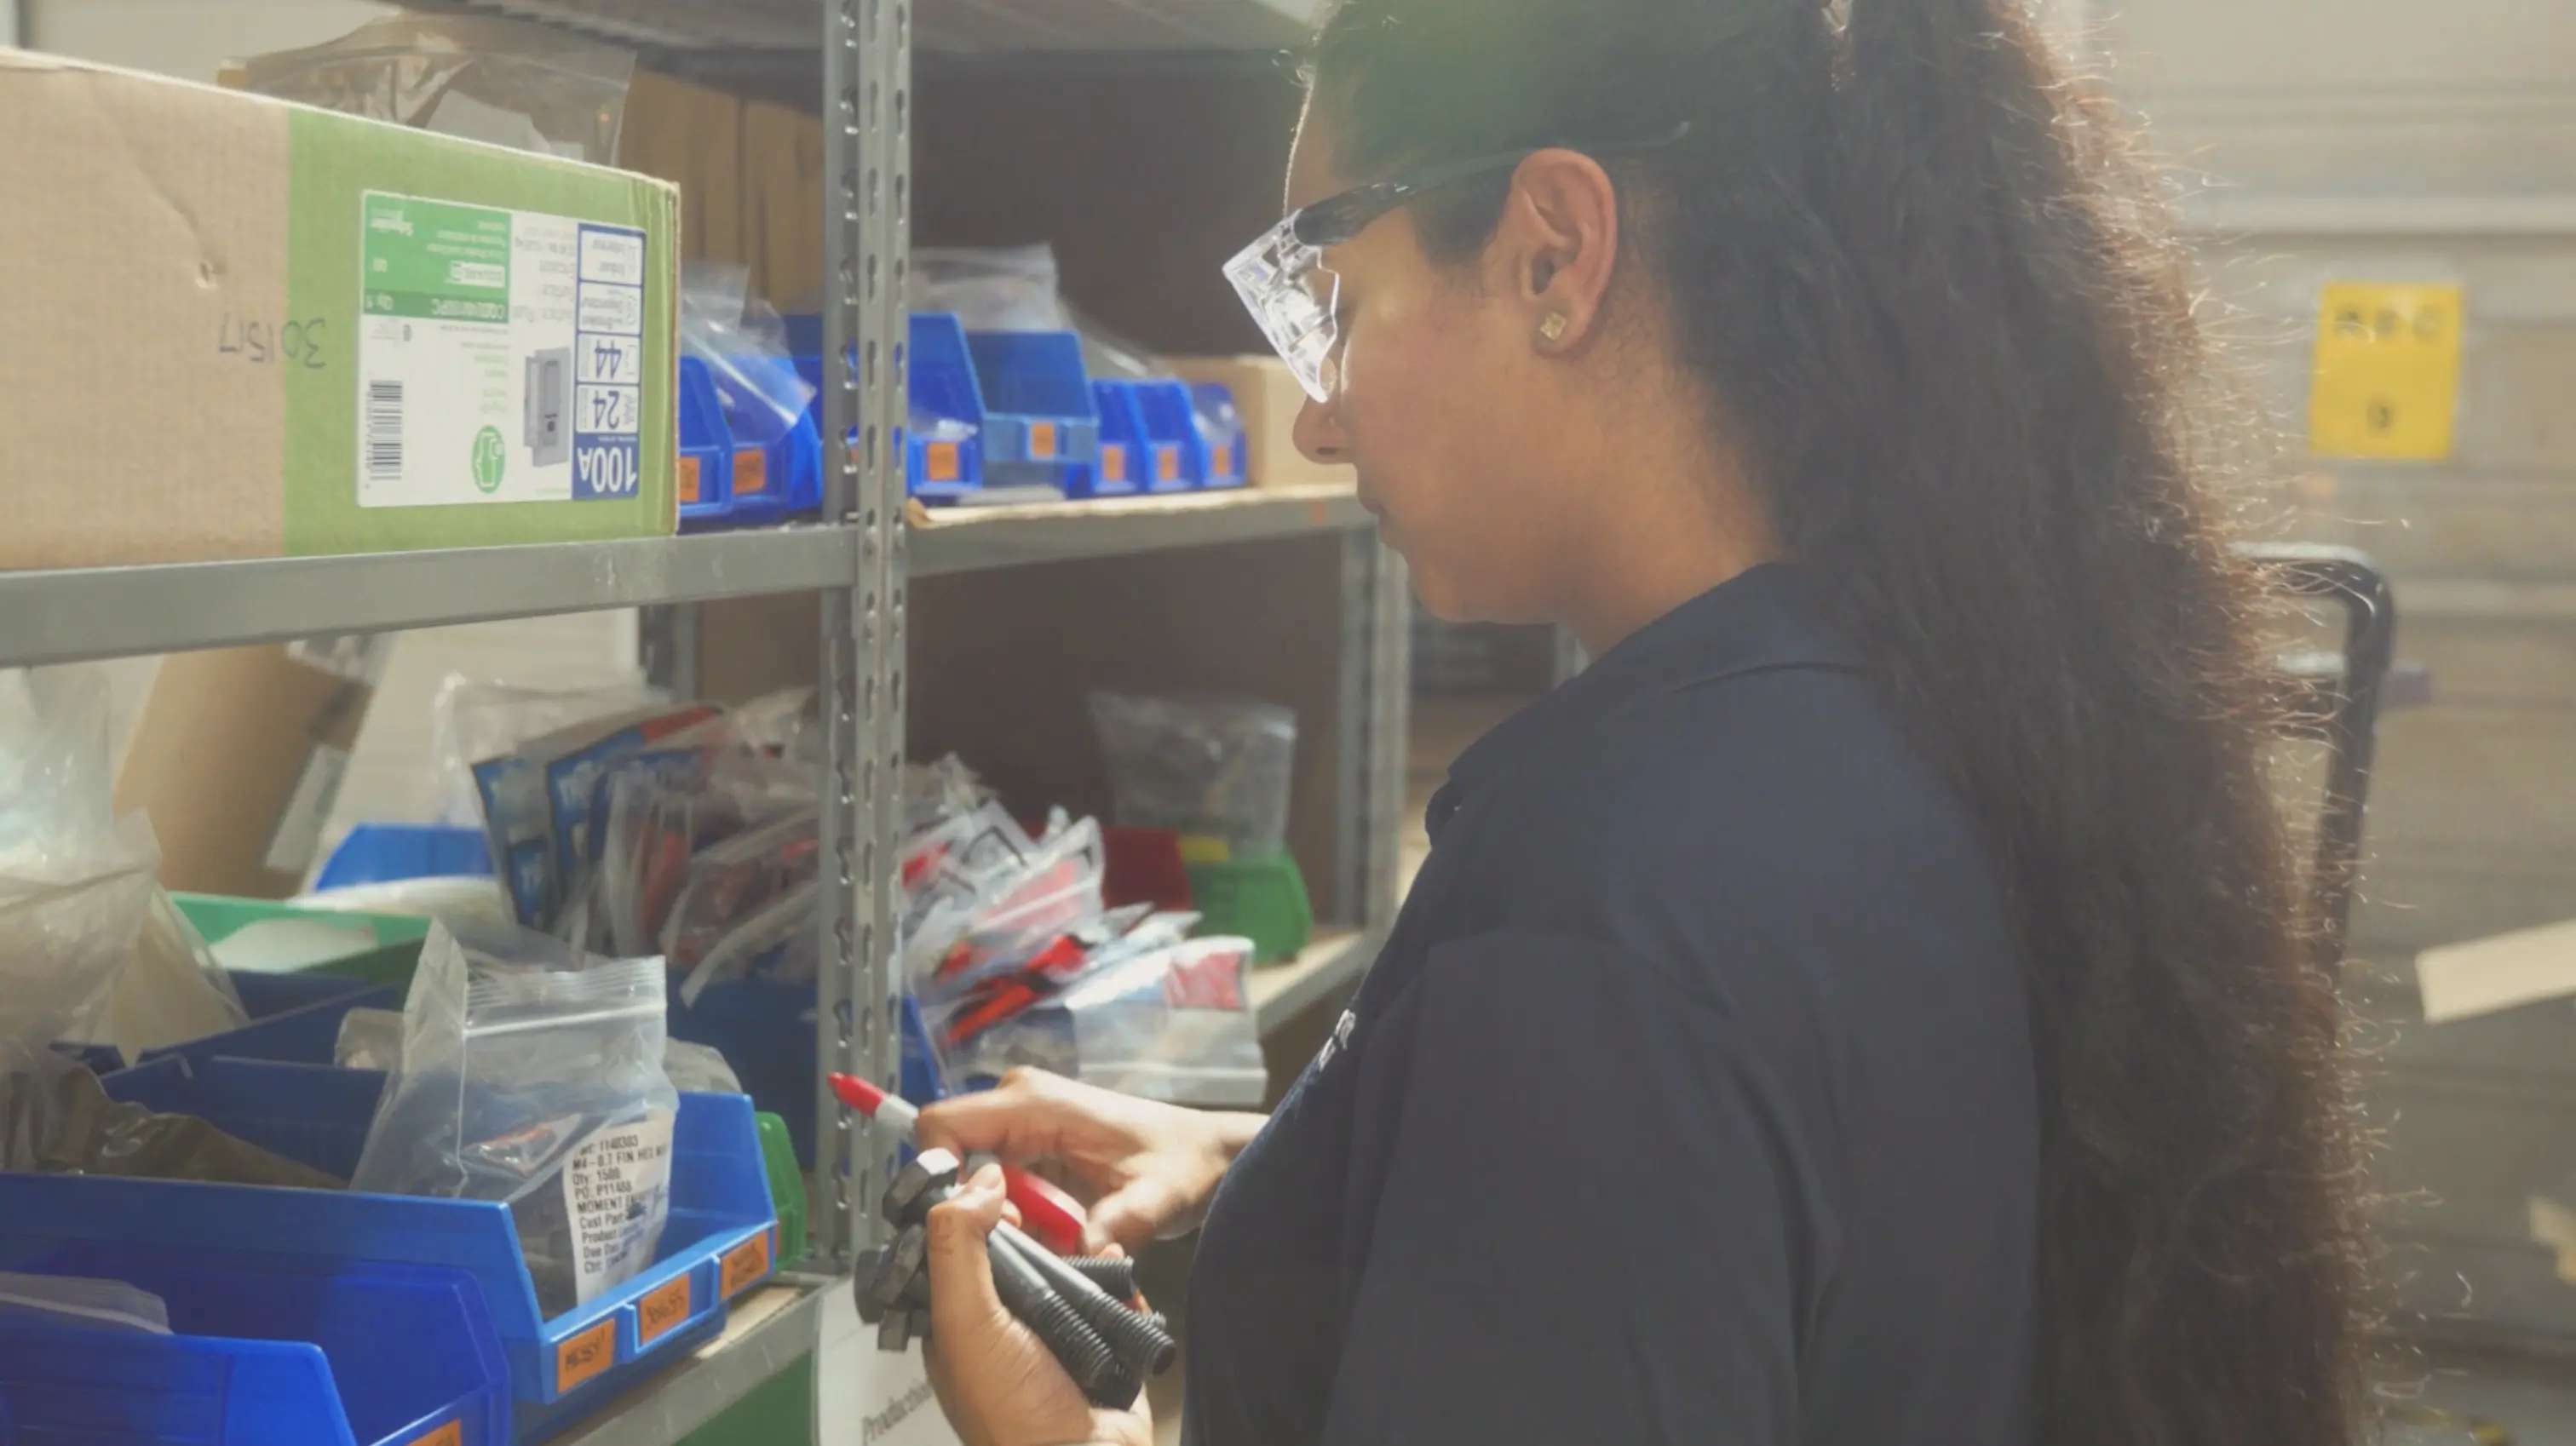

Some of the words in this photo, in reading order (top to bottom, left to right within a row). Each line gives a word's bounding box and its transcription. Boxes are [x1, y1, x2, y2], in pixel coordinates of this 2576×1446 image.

[595, 340, 622, 379] 44
[592, 390, 620, 429] 24
[577, 446, 638, 493] 100A
[577, 1197, 623, 1214] MOMENT
